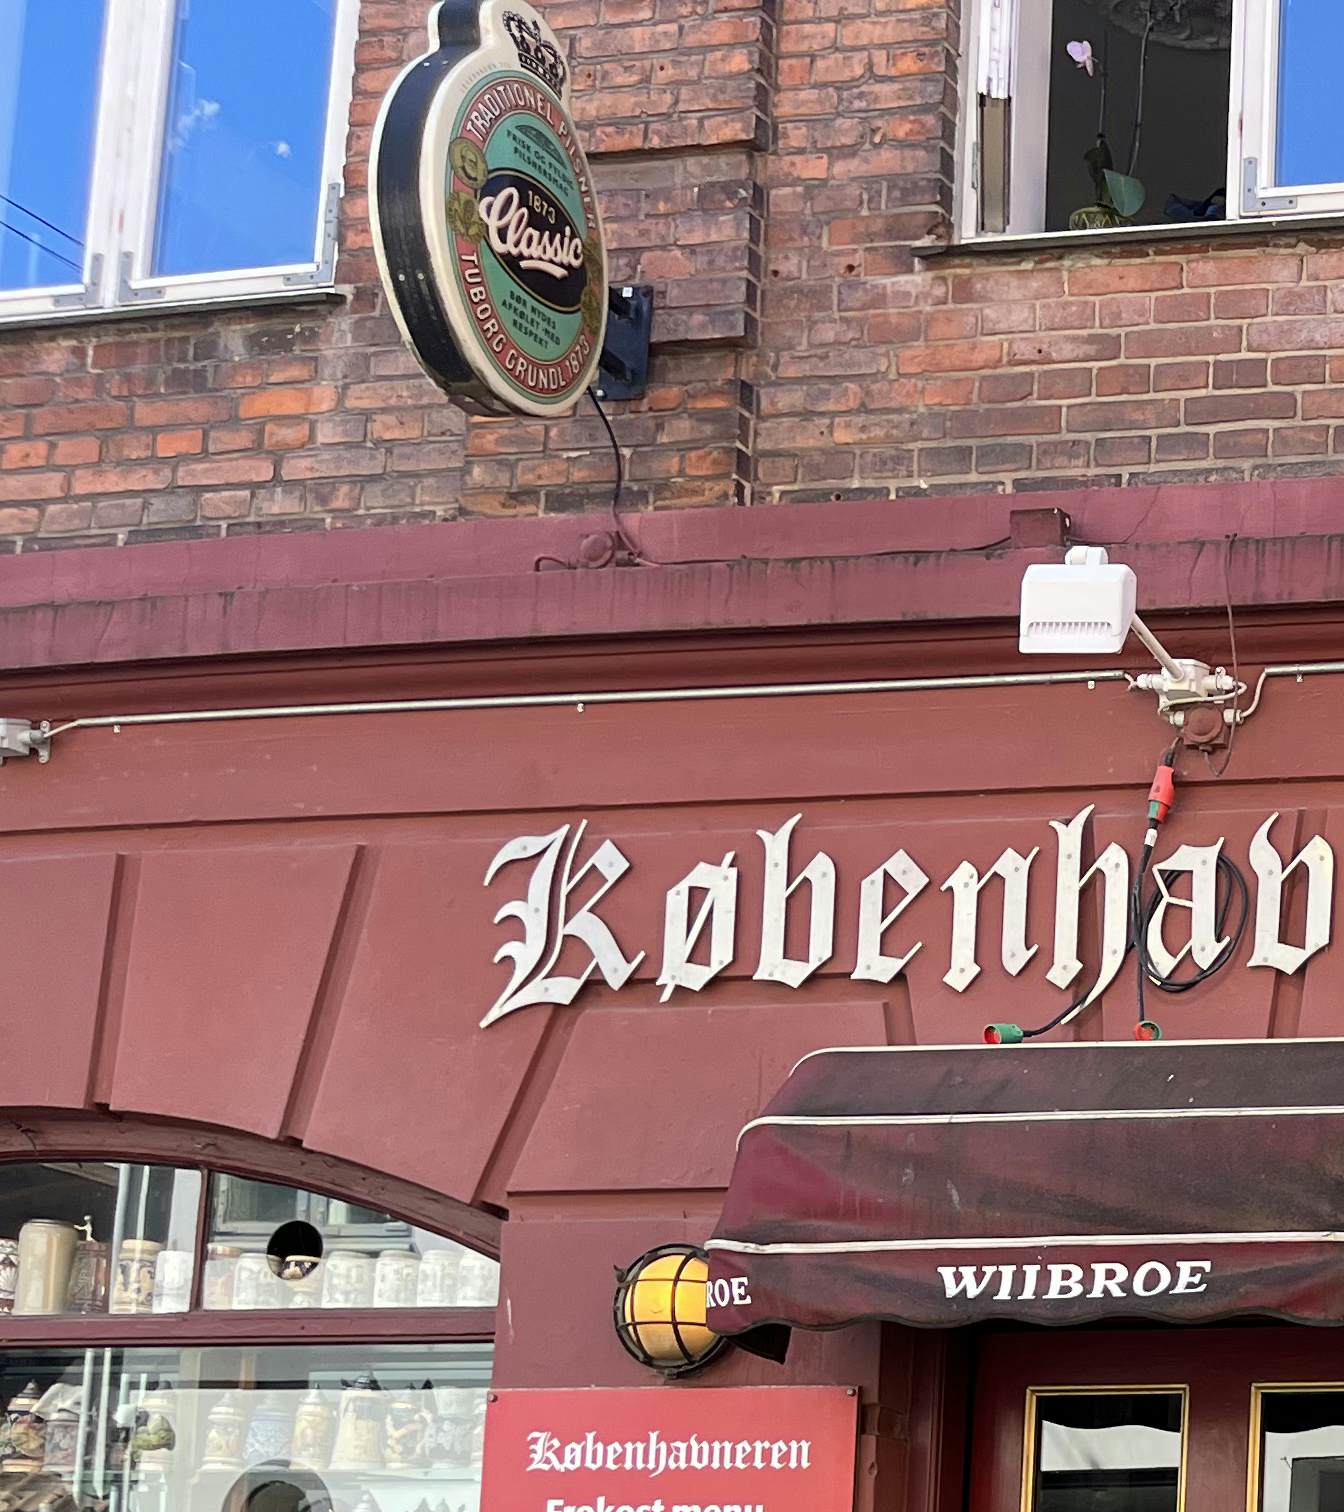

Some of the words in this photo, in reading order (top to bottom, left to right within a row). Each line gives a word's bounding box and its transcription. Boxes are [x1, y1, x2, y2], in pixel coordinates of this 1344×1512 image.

[466, 84, 554, 141] TRADITIONEL
[479, 186, 584, 269] Classic
[528, 190, 556, 224] 1873
[461, 251, 507, 353] TUBORG
[505, 349, 567, 390] GRUNDL
[566, 335, 590, 378] 1873
[937, 1259, 1213, 1302] WIIBROE
[526, 1430, 812, 1478] Københavneren
